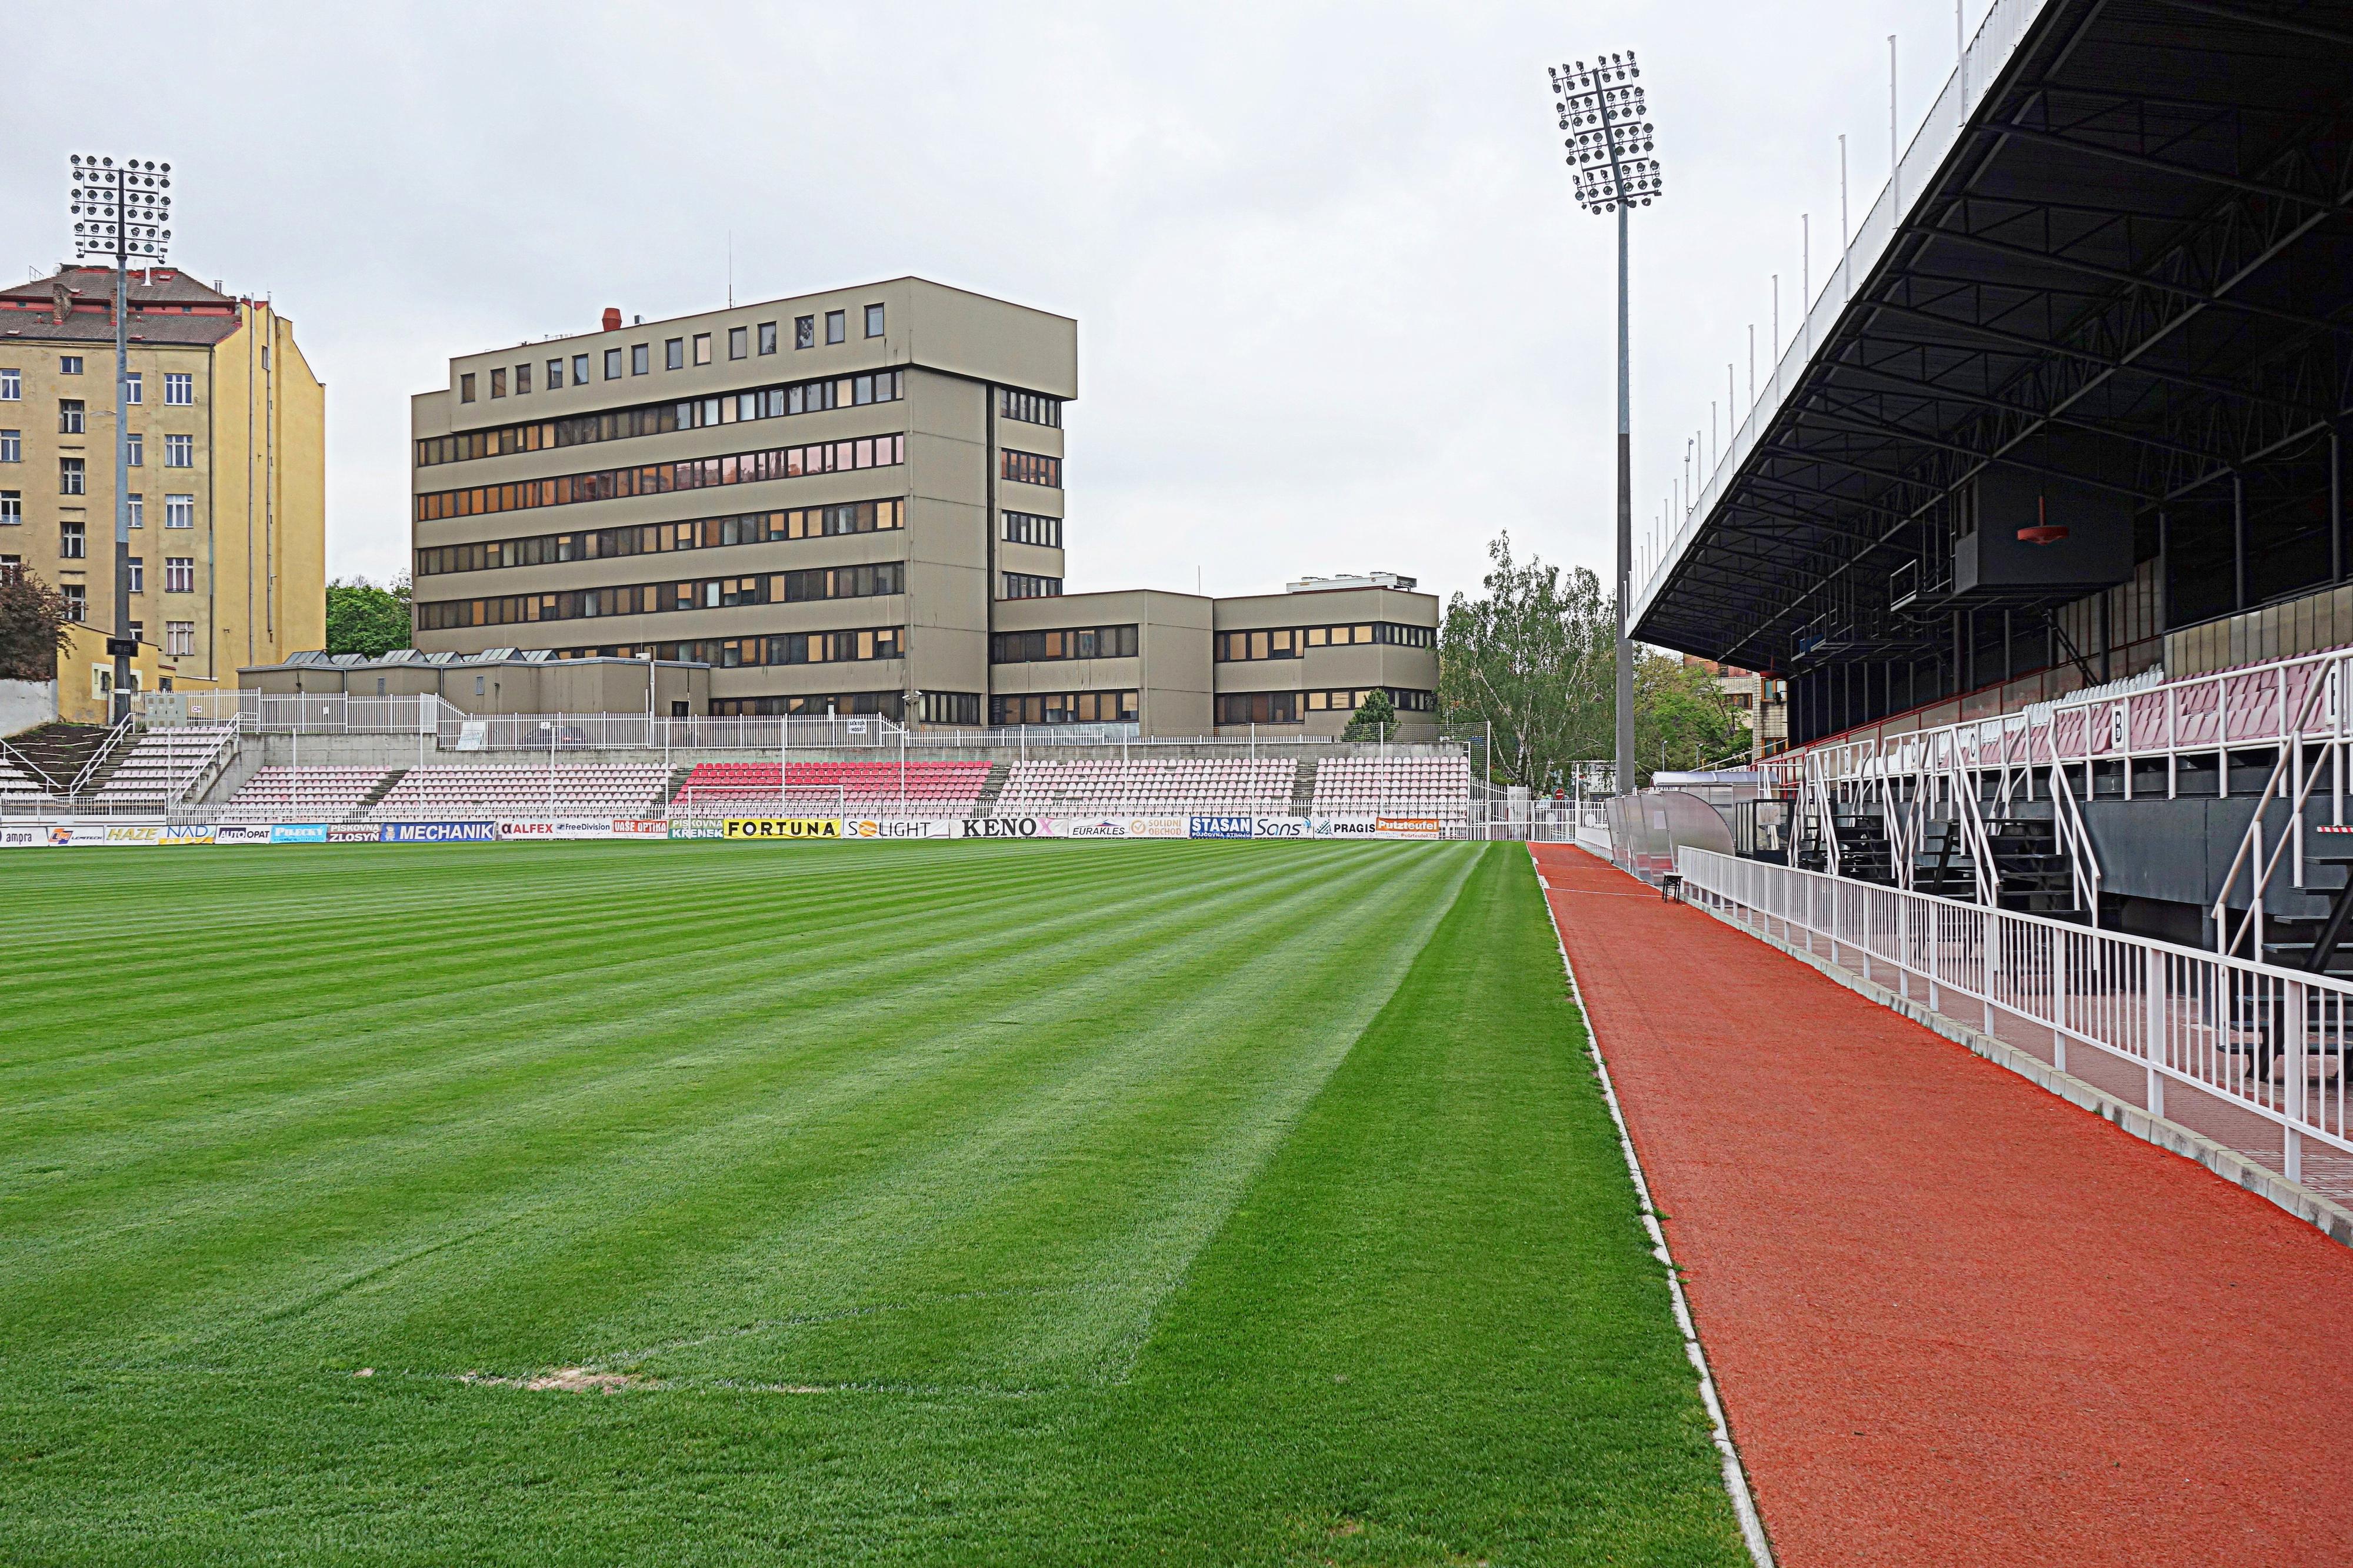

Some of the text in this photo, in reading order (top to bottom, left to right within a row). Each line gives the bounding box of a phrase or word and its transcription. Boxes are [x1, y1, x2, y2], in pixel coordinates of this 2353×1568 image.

[2115, 710, 2122, 742] B
[1912, 741, 1916, 763] C
[1970, 733, 1975, 758] C
[166, 825, 208, 838] NAD
[513, 824, 554, 833] ALFEX
[614, 821, 666, 832] VAŠE OPTIKA
[728, 822, 835, 836] FORTUNA
[962, 818, 1055, 837] KENOX
[1072, 827, 1125, 835] EURAKLES
[1192, 818, 1250, 832] STASAN
[1254, 819, 1302, 836] Sans
[1334, 824, 1375, 833] PRAGIS
[1378, 820, 1437, 830] Putzteufel
[6, 833, 32, 845] ampra
[106, 828, 159, 840] HAZE
[219, 830, 270, 839] AUTO OPAT
[399, 825, 493, 840] MECHANIK
